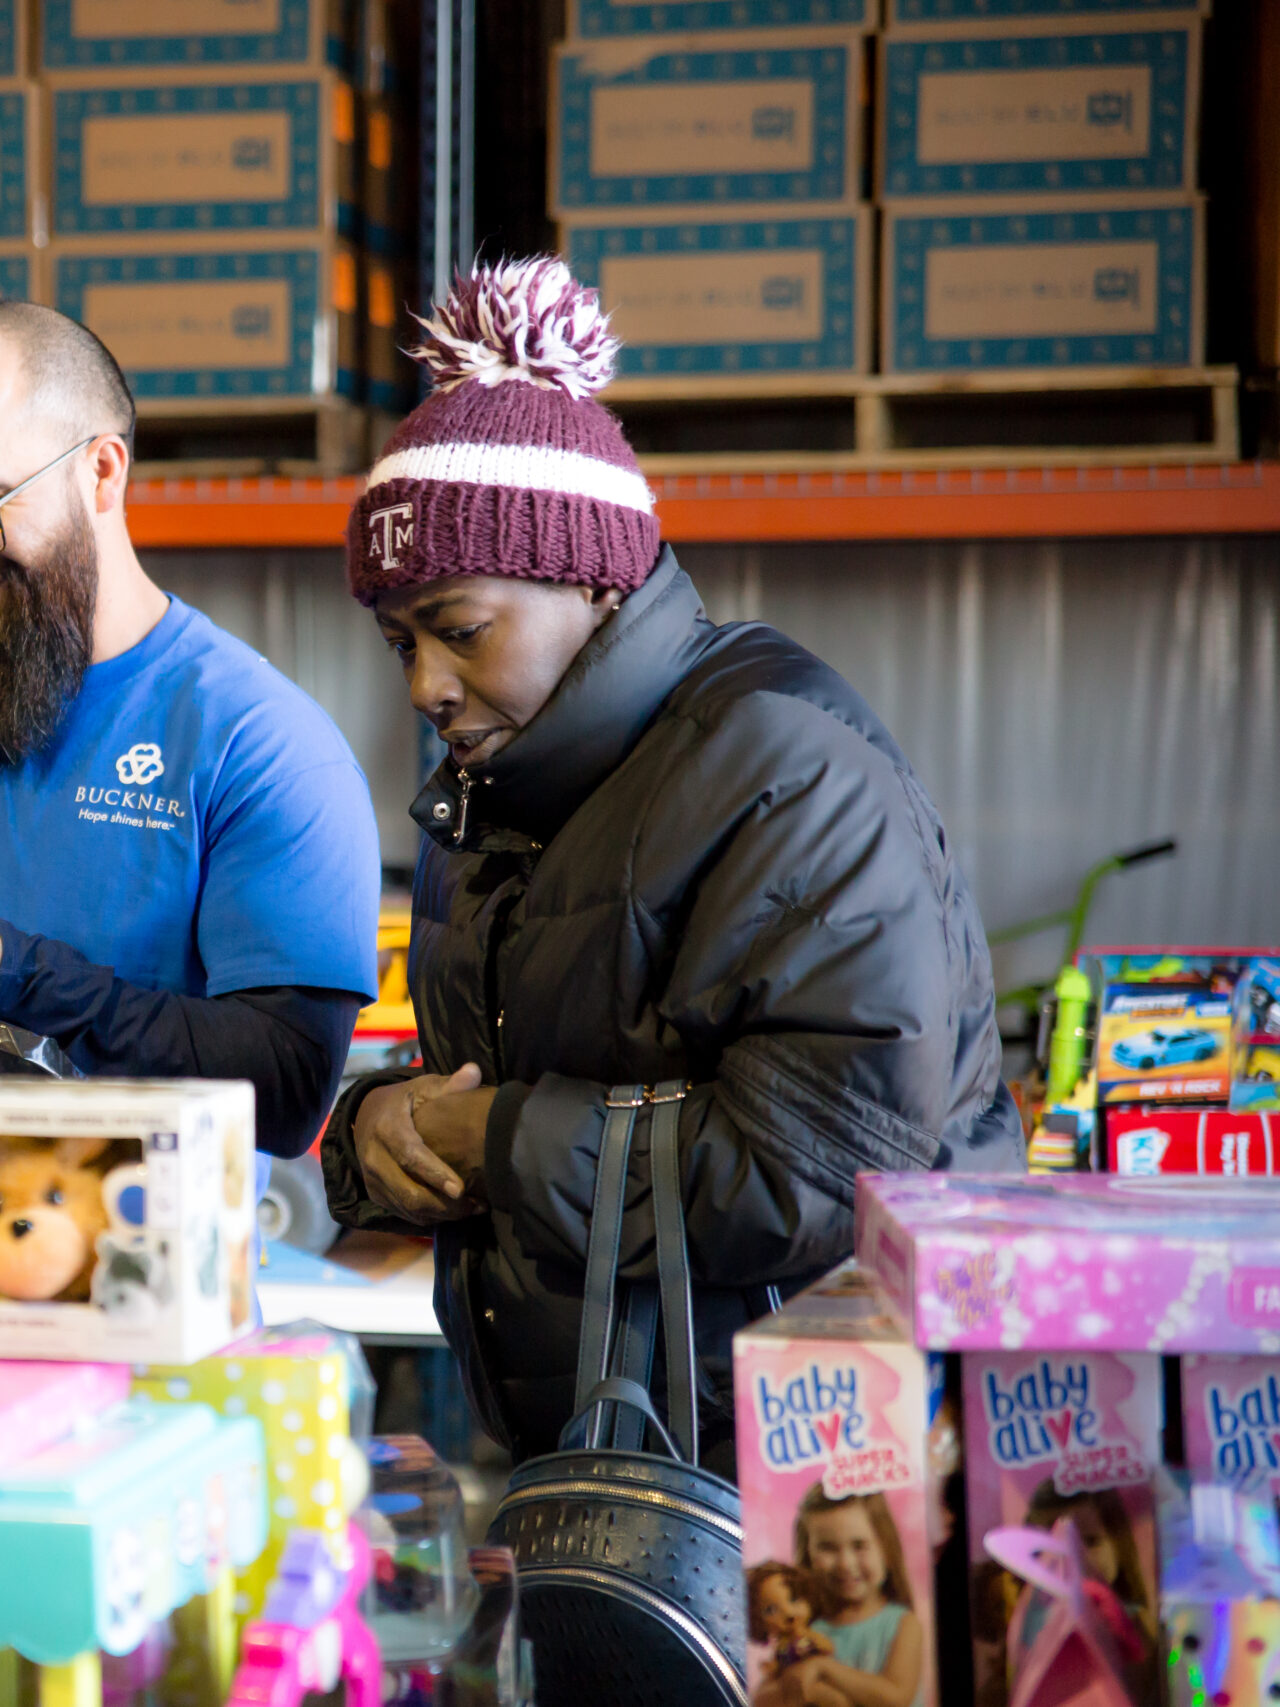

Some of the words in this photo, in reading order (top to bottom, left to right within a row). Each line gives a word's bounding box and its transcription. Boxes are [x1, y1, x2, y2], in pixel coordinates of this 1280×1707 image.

[78, 808, 108, 824] Hope
[110, 812, 144, 828] shines
[760, 1364, 857, 1424] baby
[988, 1361, 1088, 1422] baby
